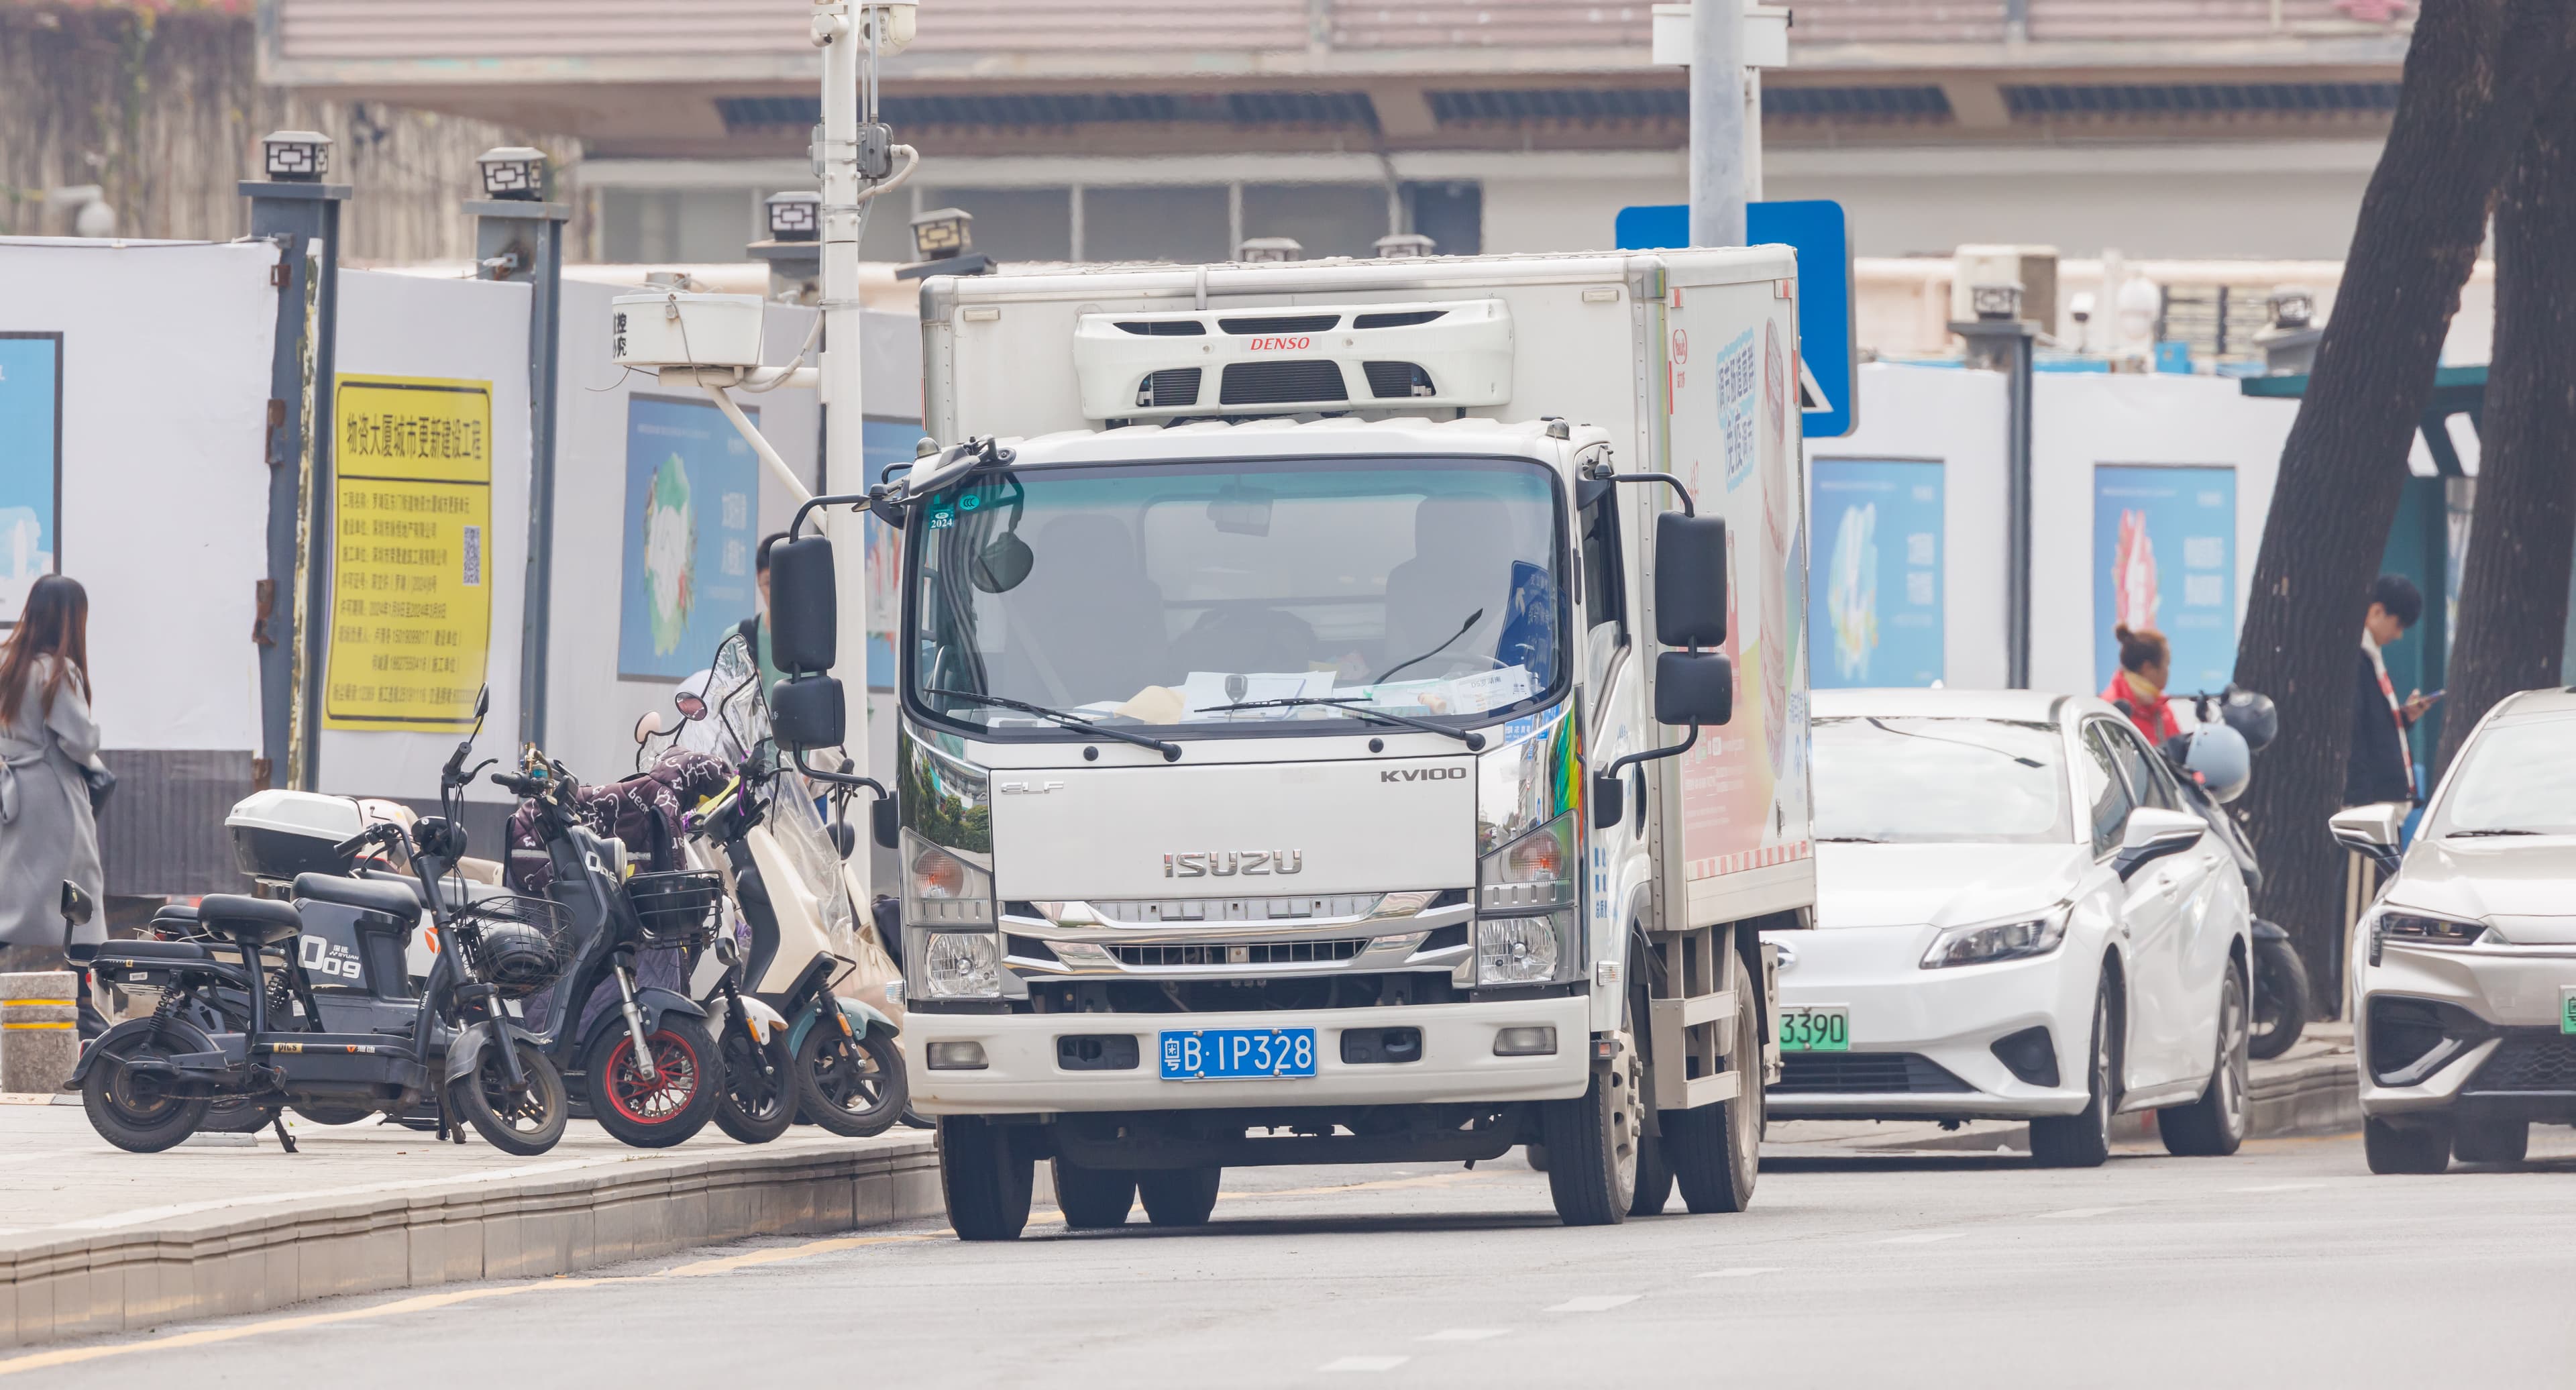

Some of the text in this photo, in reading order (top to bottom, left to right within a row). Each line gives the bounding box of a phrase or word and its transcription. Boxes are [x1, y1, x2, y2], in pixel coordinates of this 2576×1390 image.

[1250, 337, 1310, 351] DENSO
[347, 413, 482, 460] 物资大厦城市更新建设工程
[930, 519, 953, 529] 2024
[1381, 767, 1467, 782] KV100
[1001, 781, 1064, 794] ELF
[628, 787, 649, 814] bear
[1164, 849, 1303, 877] ISUZU
[419, 990, 430, 1010] YADEA
[1780, 1014, 1843, 1043] 3390
